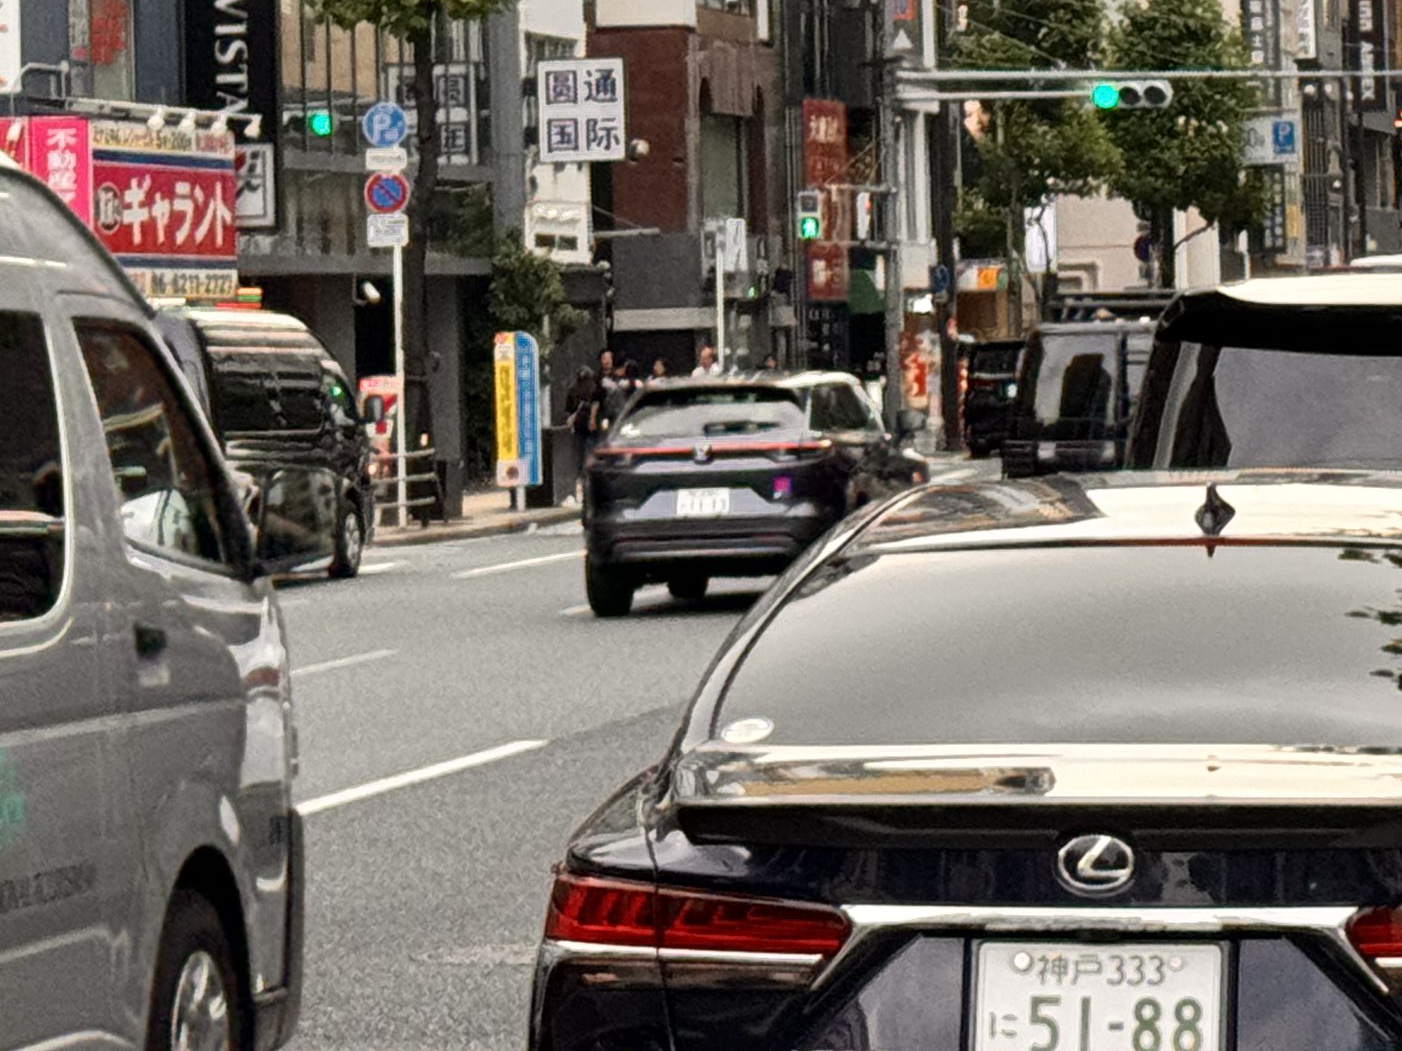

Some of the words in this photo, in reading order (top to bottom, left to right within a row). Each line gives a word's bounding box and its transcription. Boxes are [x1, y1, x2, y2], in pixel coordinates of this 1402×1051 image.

[122, 173, 233, 249] ギャラント
[989, 1011, 1018, 1039] に
[1029, 995, 1203, 1051] 51-88
